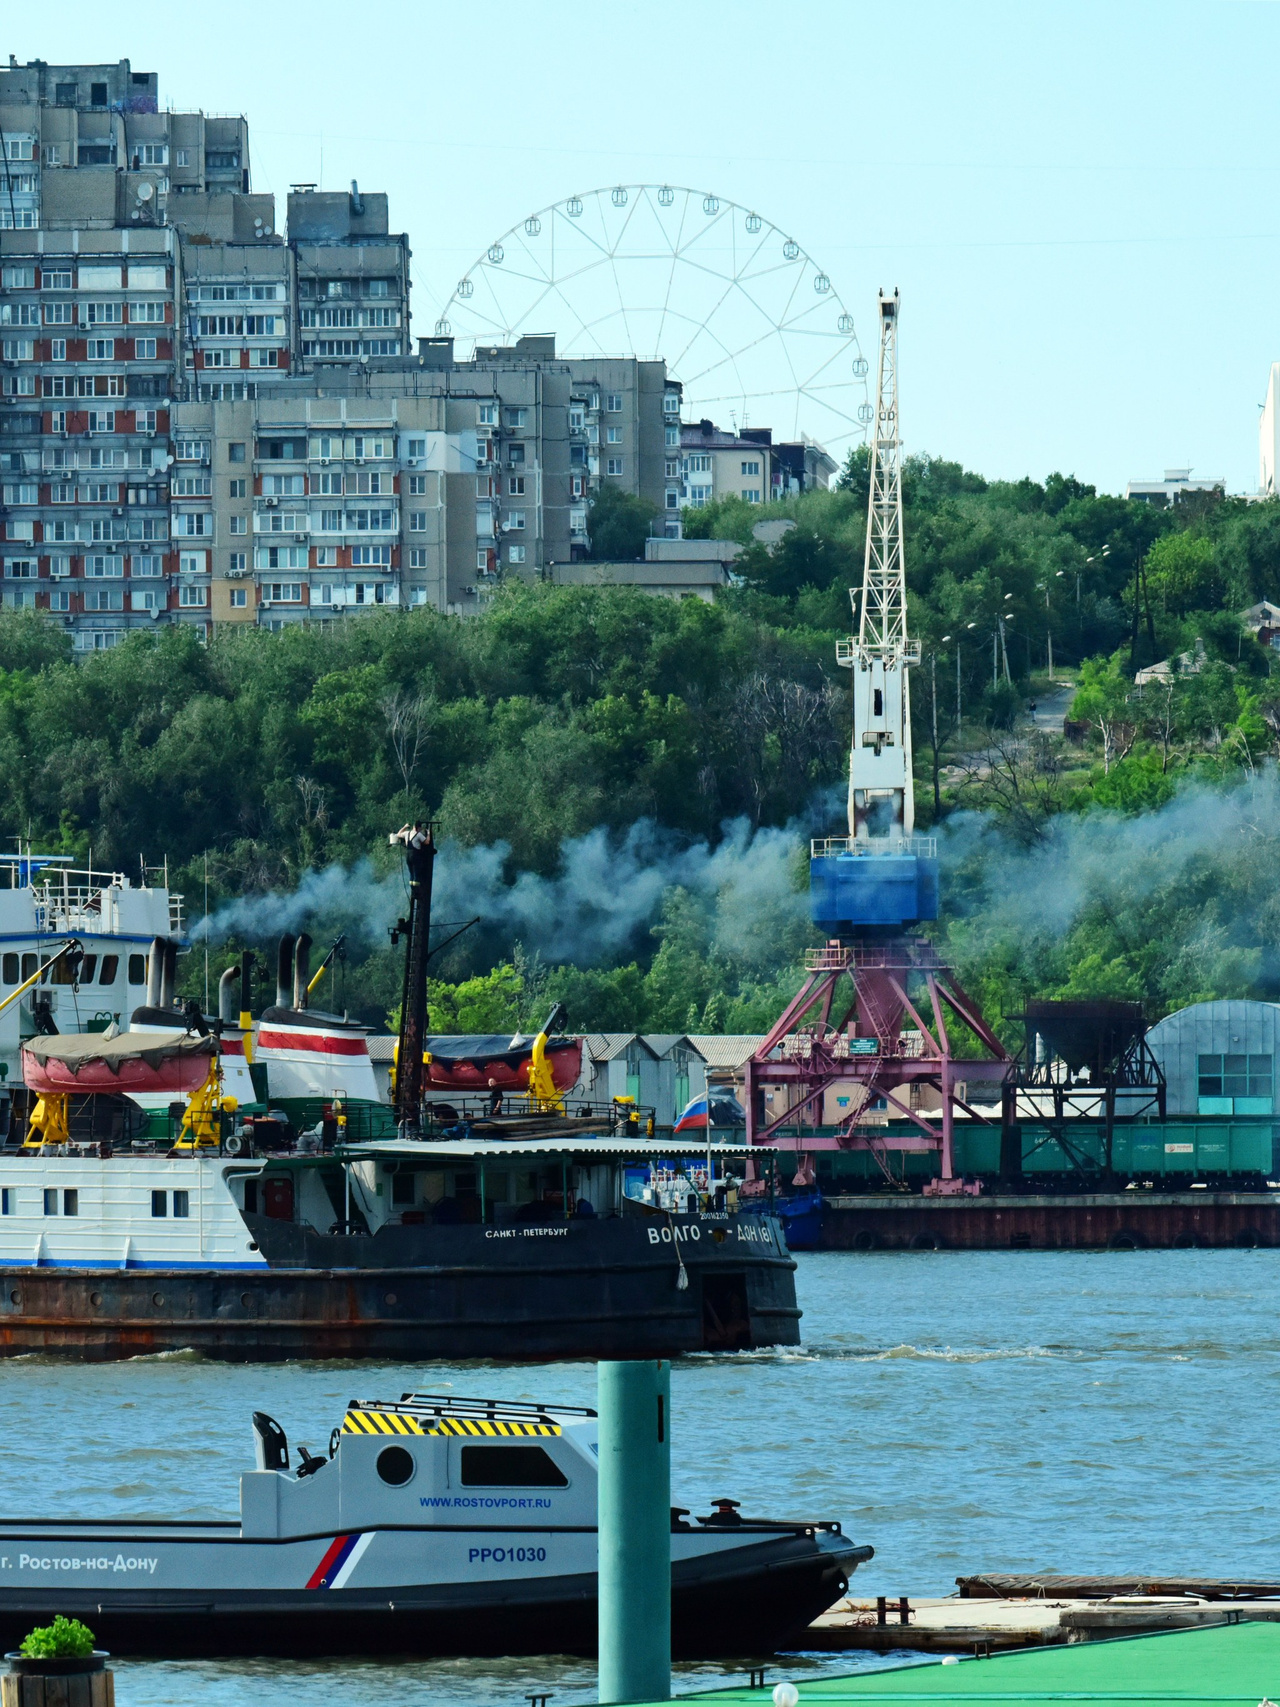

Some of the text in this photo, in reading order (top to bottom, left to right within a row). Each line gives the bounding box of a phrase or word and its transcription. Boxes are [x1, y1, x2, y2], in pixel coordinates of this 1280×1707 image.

[647, 1224, 701, 1244] ВОЛГО
[420, 1497, 551, 1508] WWW.ROSTOVPORT.RU
[1, 1556, 13, 1568] г.
[19, 1554, 158, 1574] Ростов-на-Дону
